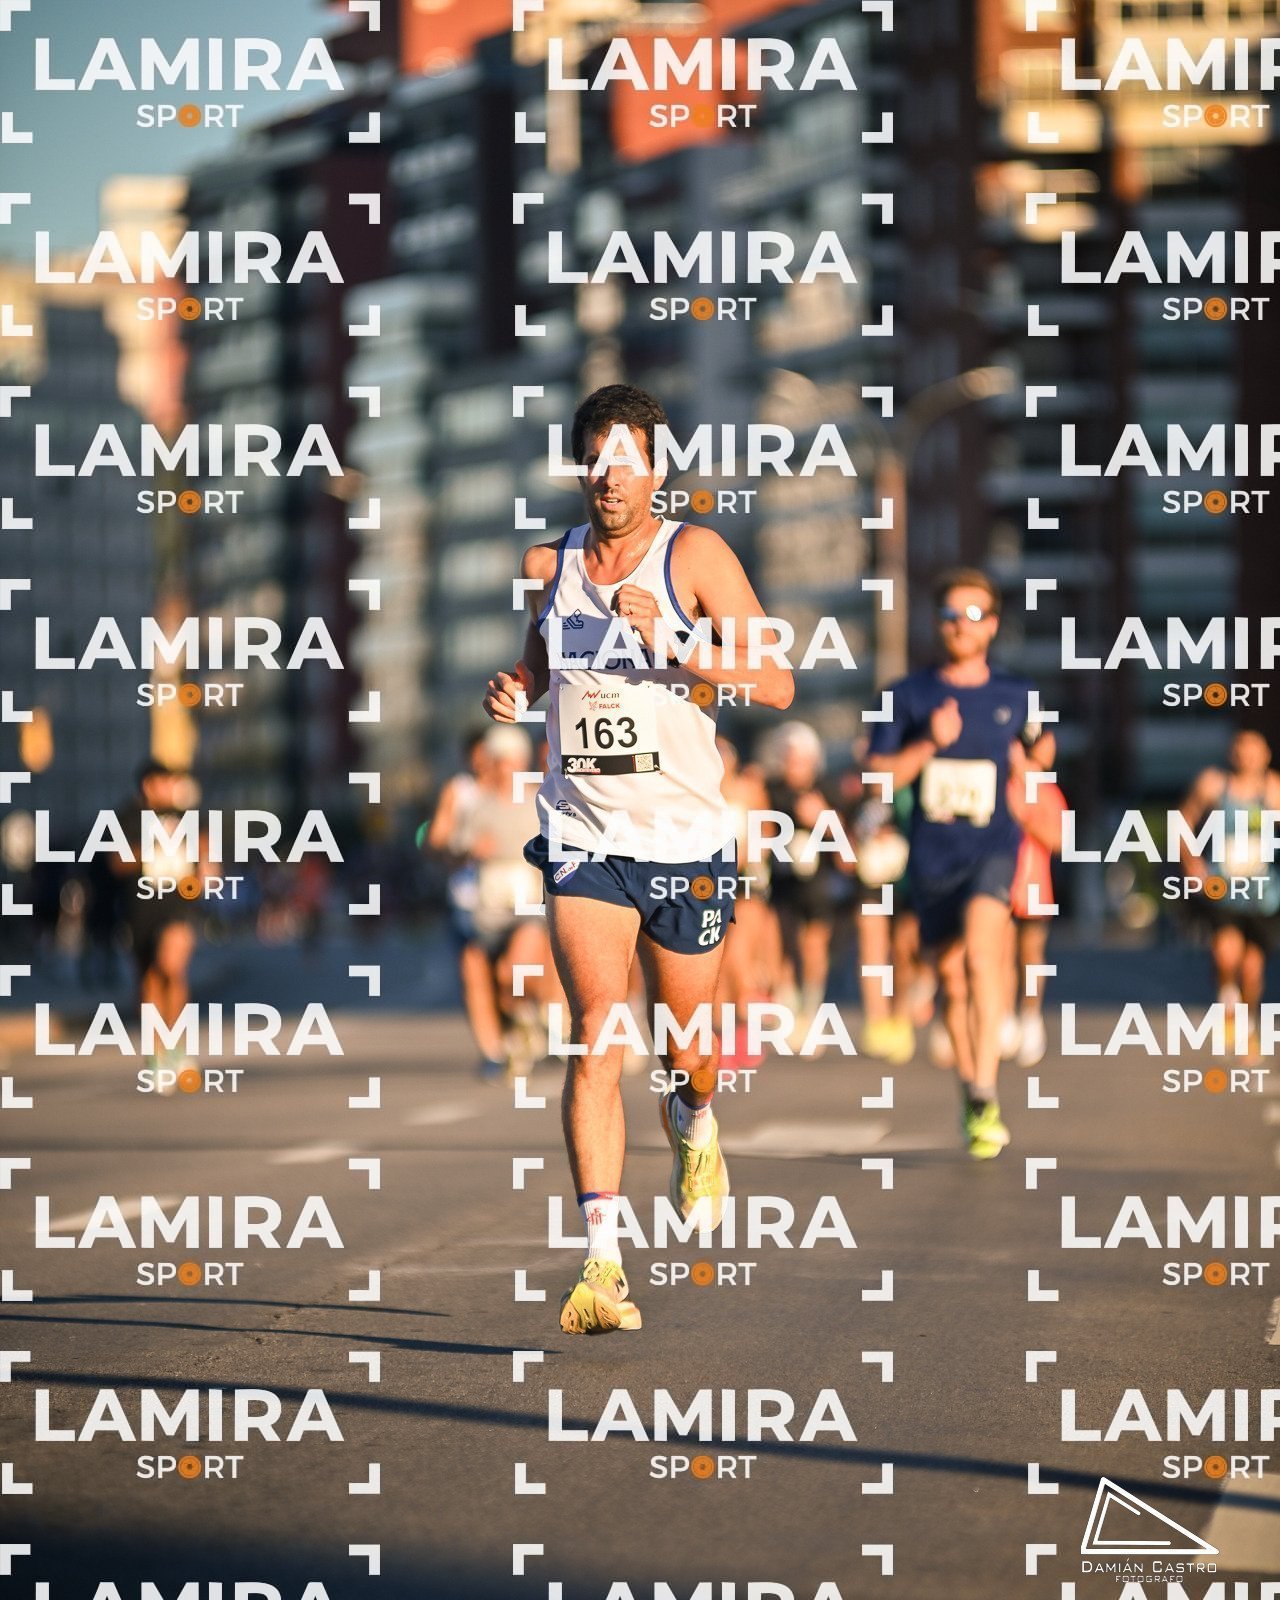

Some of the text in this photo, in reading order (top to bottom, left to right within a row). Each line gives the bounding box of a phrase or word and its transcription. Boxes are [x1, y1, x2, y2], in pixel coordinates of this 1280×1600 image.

[575, 717, 638, 749] 163
[566, 757, 597, 773] 30K
[701, 908, 722, 928] PA
[698, 925, 721, 946] CK
